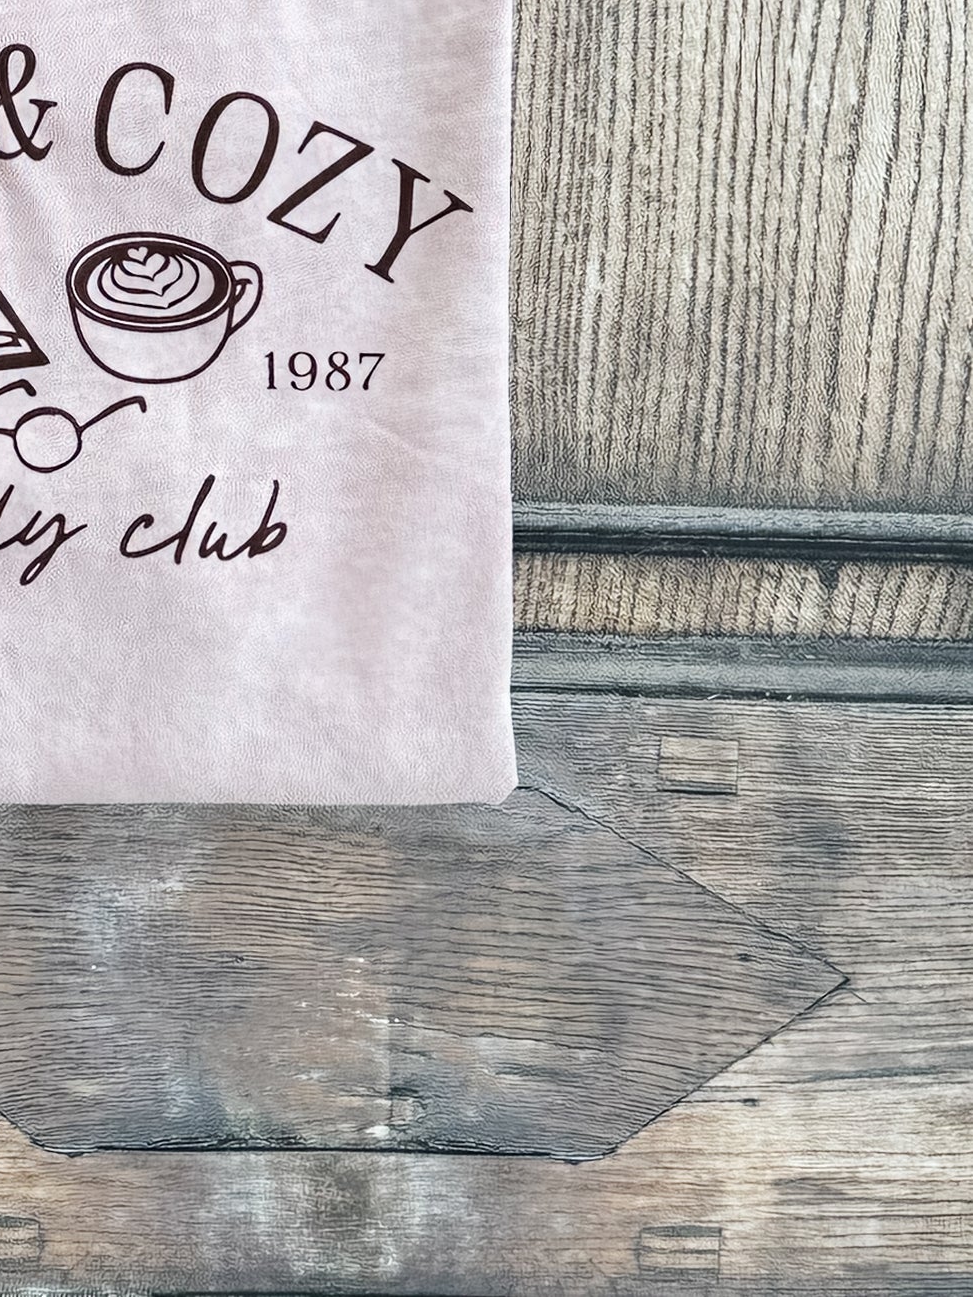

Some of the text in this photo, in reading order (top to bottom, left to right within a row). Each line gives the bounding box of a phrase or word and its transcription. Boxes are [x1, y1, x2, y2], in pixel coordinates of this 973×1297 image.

[93, 61, 475, 284] COZY
[264, 350, 387, 392] 1987
[119, 473, 289, 565] club
